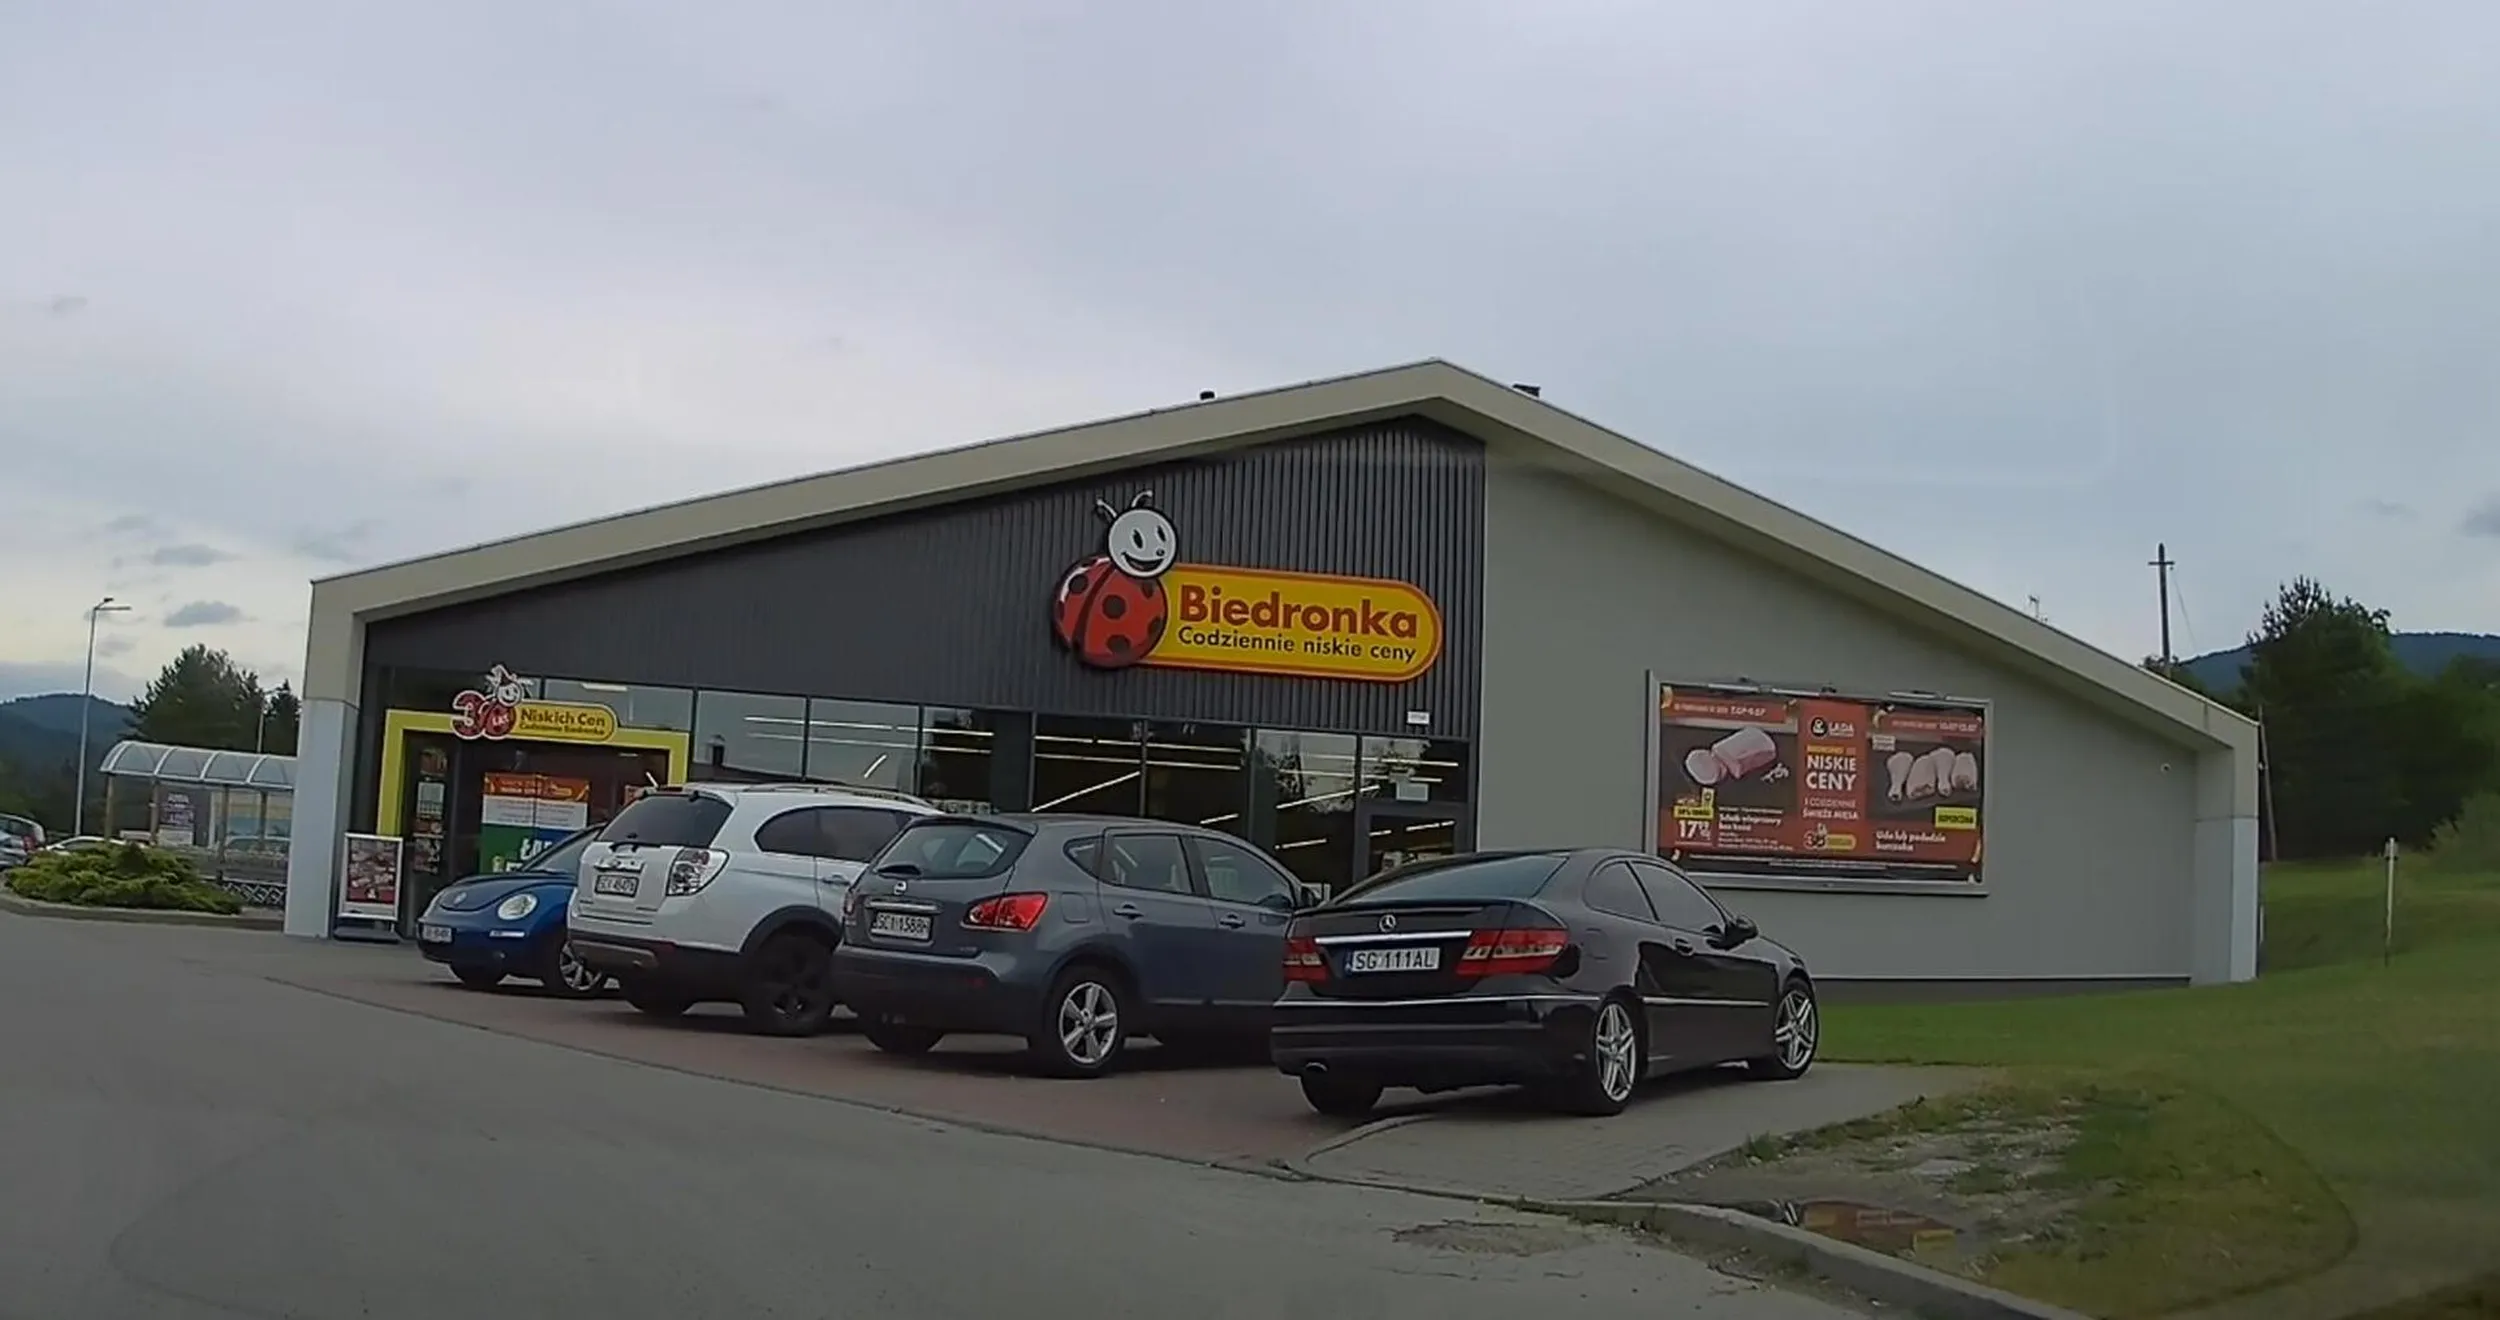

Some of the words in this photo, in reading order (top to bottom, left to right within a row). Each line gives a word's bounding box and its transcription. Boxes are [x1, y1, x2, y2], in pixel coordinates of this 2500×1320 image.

[1180, 584, 1417, 639] Biedronka
[1179, 625, 1295, 652] Codziennie
[1303, 637, 1362, 657] niskie
[1370, 645, 1416, 664] ceny
[520, 708, 574, 725] Niskich
[577, 712, 605, 726] Cen
[1807, 754, 1857, 772] NISKIE
[1806, 772, 1857, 791] CENY
[1355, 952, 1377, 970] SG
[1385, 950, 1435, 970] 111AL
